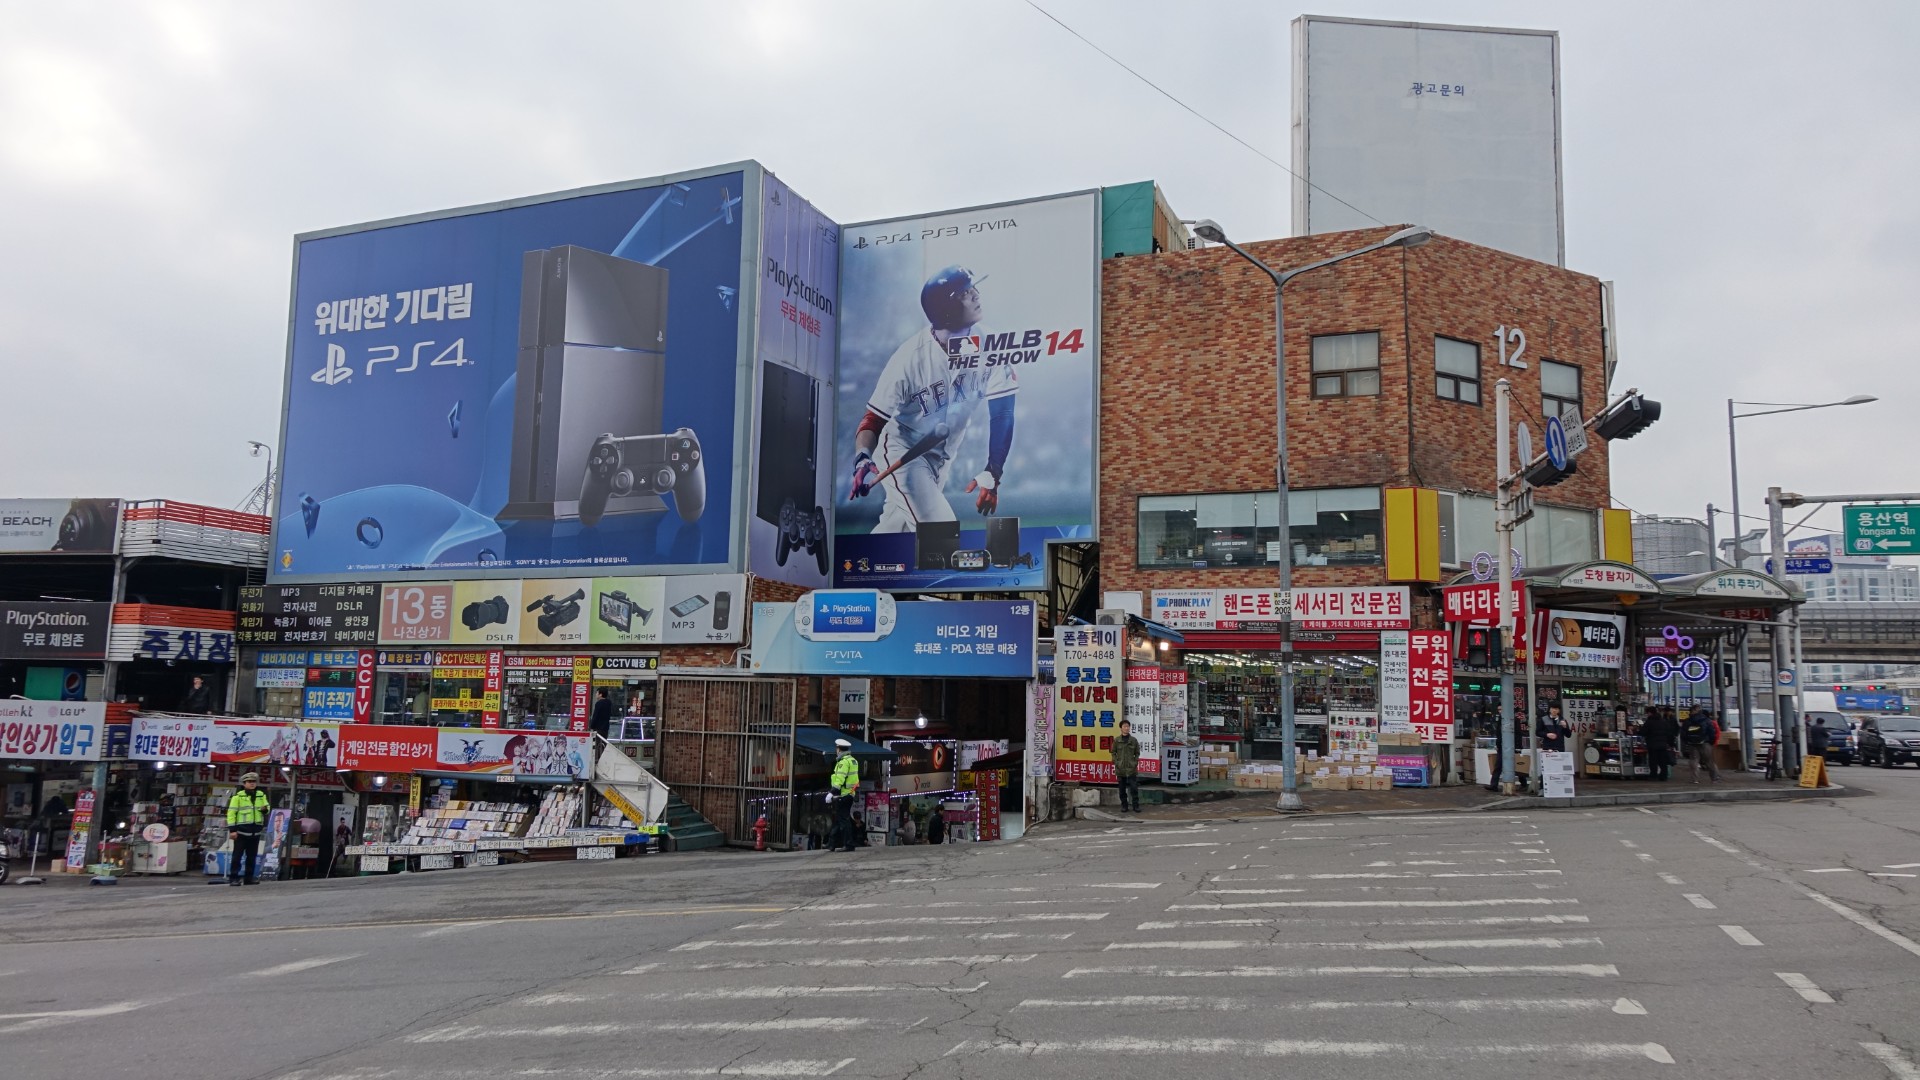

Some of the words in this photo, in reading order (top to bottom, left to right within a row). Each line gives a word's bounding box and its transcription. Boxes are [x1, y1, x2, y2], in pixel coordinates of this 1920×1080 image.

[1412, 82, 1464, 96] 광고문의
[876, 233, 911, 245] PS4
[922, 226, 959, 240] PS3
[767, 257, 833, 316] PlayStation
[315, 294, 389, 336] 위대한
[394, 282, 473, 325] 기다림
[781, 300, 797, 323] 무료
[799, 310, 821, 337] 체험존
[983, 329, 1042, 352] MLB
[1045, 329, 1084, 356] 14
[1493, 325, 1528, 369] 12
[366, 338, 468, 376] PS4
[948, 356, 980, 370] THE
[985, 349, 1041, 367] SHOW
[3, 516, 53, 527] BEACH
[1858, 511, 1909, 526] 용산역
[1859, 527, 1896, 537] Yongsan
[1900, 526, 1915, 535] Stn
[1859, 541, 1869, 549] 21
[1585, 569, 1603, 581] 도청
[1606, 570, 1634, 583] 탐지기
[1718, 578, 1735, 589] 위치
[1737, 579, 1763, 590] 추적기
[240, 588, 263, 598] 무전기
[281, 588, 300, 597] MP3
[320, 586, 345, 596] 디지털
[348, 586, 374, 596] 카메라
[242, 602, 264, 612] 전화기
[283, 602, 317, 612] 전자사전
[336, 602, 363, 611] DSLR
[833, 604, 870, 613] PlayStation
[1010, 605, 1030, 615] 12동
[1224, 593, 1272, 616] 핸드폰
[1294, 592, 1344, 616] 세서리
[1350, 591, 1402, 616] 전문점
[6, 610, 87, 629] PlayStation
[1162, 611, 1207, 619] 중고폰전문
[1724, 608, 1766, 619] 무전기
[240, 617, 263, 627] 게임기
[274, 617, 297, 627] 녹음기
[308, 616, 332, 627] 이어폰
[344, 616, 369, 626] 쌍안경
[671, 621, 695, 629] MP3
[237, 632, 253, 641] 각종
[254, 631, 277, 641] 밧데리
[284, 631, 327, 641] 전자번호키
[334, 630, 375, 641] 네비게이션
[393, 626, 442, 639] 나진상가
[618, 633, 656, 641] 네비게이션
[706, 632, 732, 640] 녹음기
[937, 625, 970, 638] 비디오
[974, 625, 998, 638] 게임
[1063, 630, 1117, 647] 폰플레이
[1583, 626, 1609, 643] 배터리
[23, 633, 45, 647] 무료
[49, 632, 84, 647] 체험존
[142, 630, 235, 663] 주차장
[914, 642, 941, 654] 휴대폰
[951, 643, 973, 654] PDA
[975, 643, 994, 654] 전문
[997, 643, 1017, 654] 매장
[1064, 650, 1115, 660] T.704-4848
[1549, 650, 1566, 659] MBC
[261, 653, 305, 665] 네비게이션
[313, 653, 356, 665] 블랙박스
[508, 657, 524, 666] GSM
[525, 657, 538, 666] Used
[539, 657, 555, 666] Phone
[556, 657, 573, 666] 중고폰
[283, 670, 304, 680] 블랙박스
[488, 652, 500, 690] 컴퓨터
[1066, 667, 1112, 684] 중고폰
[1412, 635, 1430, 720] 무전기
[1431, 635, 1449, 720] 위치추적기
[357, 653, 373, 715] CCTV
[308, 691, 325, 709] 위치
[326, 691, 354, 709] 추적기
[486, 693, 499, 701] 판매
[574, 684, 588, 718] 중고폰
[844, 693, 865, 703] KTF
[1060, 685, 1118, 703] 매입/판매
[60, 708, 71, 716] LG
[73, 707, 86, 716] U+
[1063, 709, 1116, 728] 선불폰
[1414, 725, 1448, 741] 전문
[1571, 723, 1587, 733] A/S
[60, 724, 94, 756] 입구
[135, 734, 159, 755] 휴대폰
[160, 735, 192, 757] 할인상가
[193, 737, 209, 758] 입구
[1063, 734, 1115, 753] 배터리
[346, 740, 366, 755] 게임
[368, 741, 388, 756] 전문
[390, 742, 410, 757] 할인
[411, 743, 433, 758] 상가
[346, 759, 359, 767] 지하
[1167, 749, 1181, 782] 배터리
[1058, 762, 1087, 779] 스마트폰
